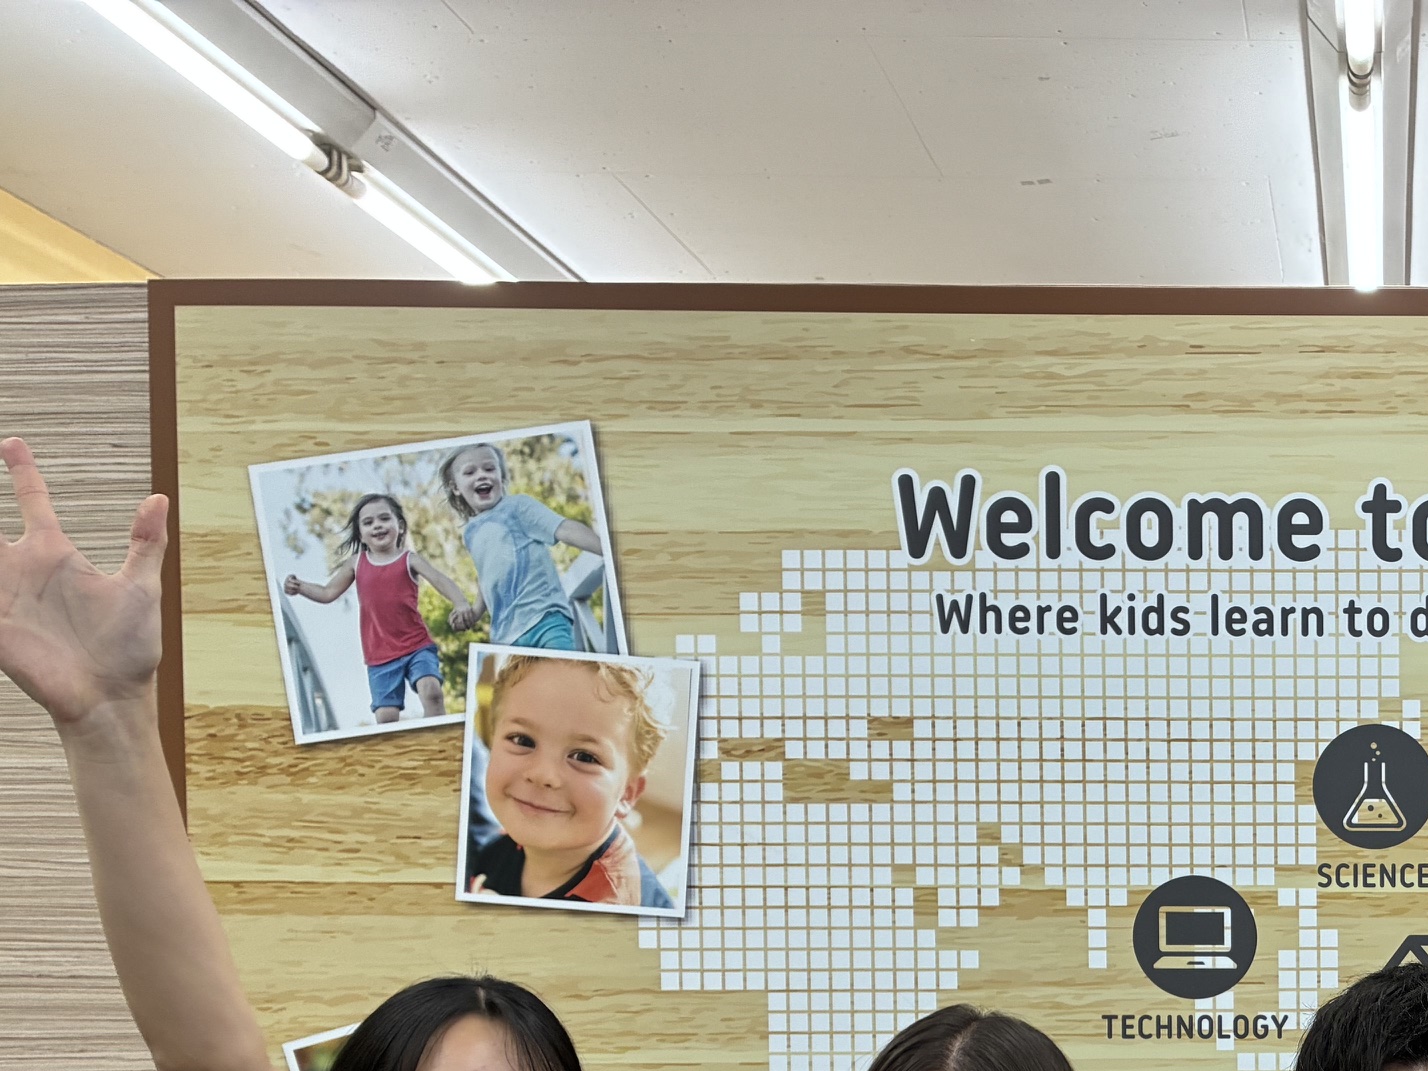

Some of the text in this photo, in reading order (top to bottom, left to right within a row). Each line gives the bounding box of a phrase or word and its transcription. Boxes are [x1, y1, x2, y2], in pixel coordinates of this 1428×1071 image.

[897, 470, 1324, 562] Welcome
[934, 592, 1080, 636] Where
[1099, 592, 1191, 636] kids
[1210, 593, 1325, 637] learn
[1347, 599, 1391, 638] to
[1101, 1014, 1290, 1039] TECHNOLOGY
